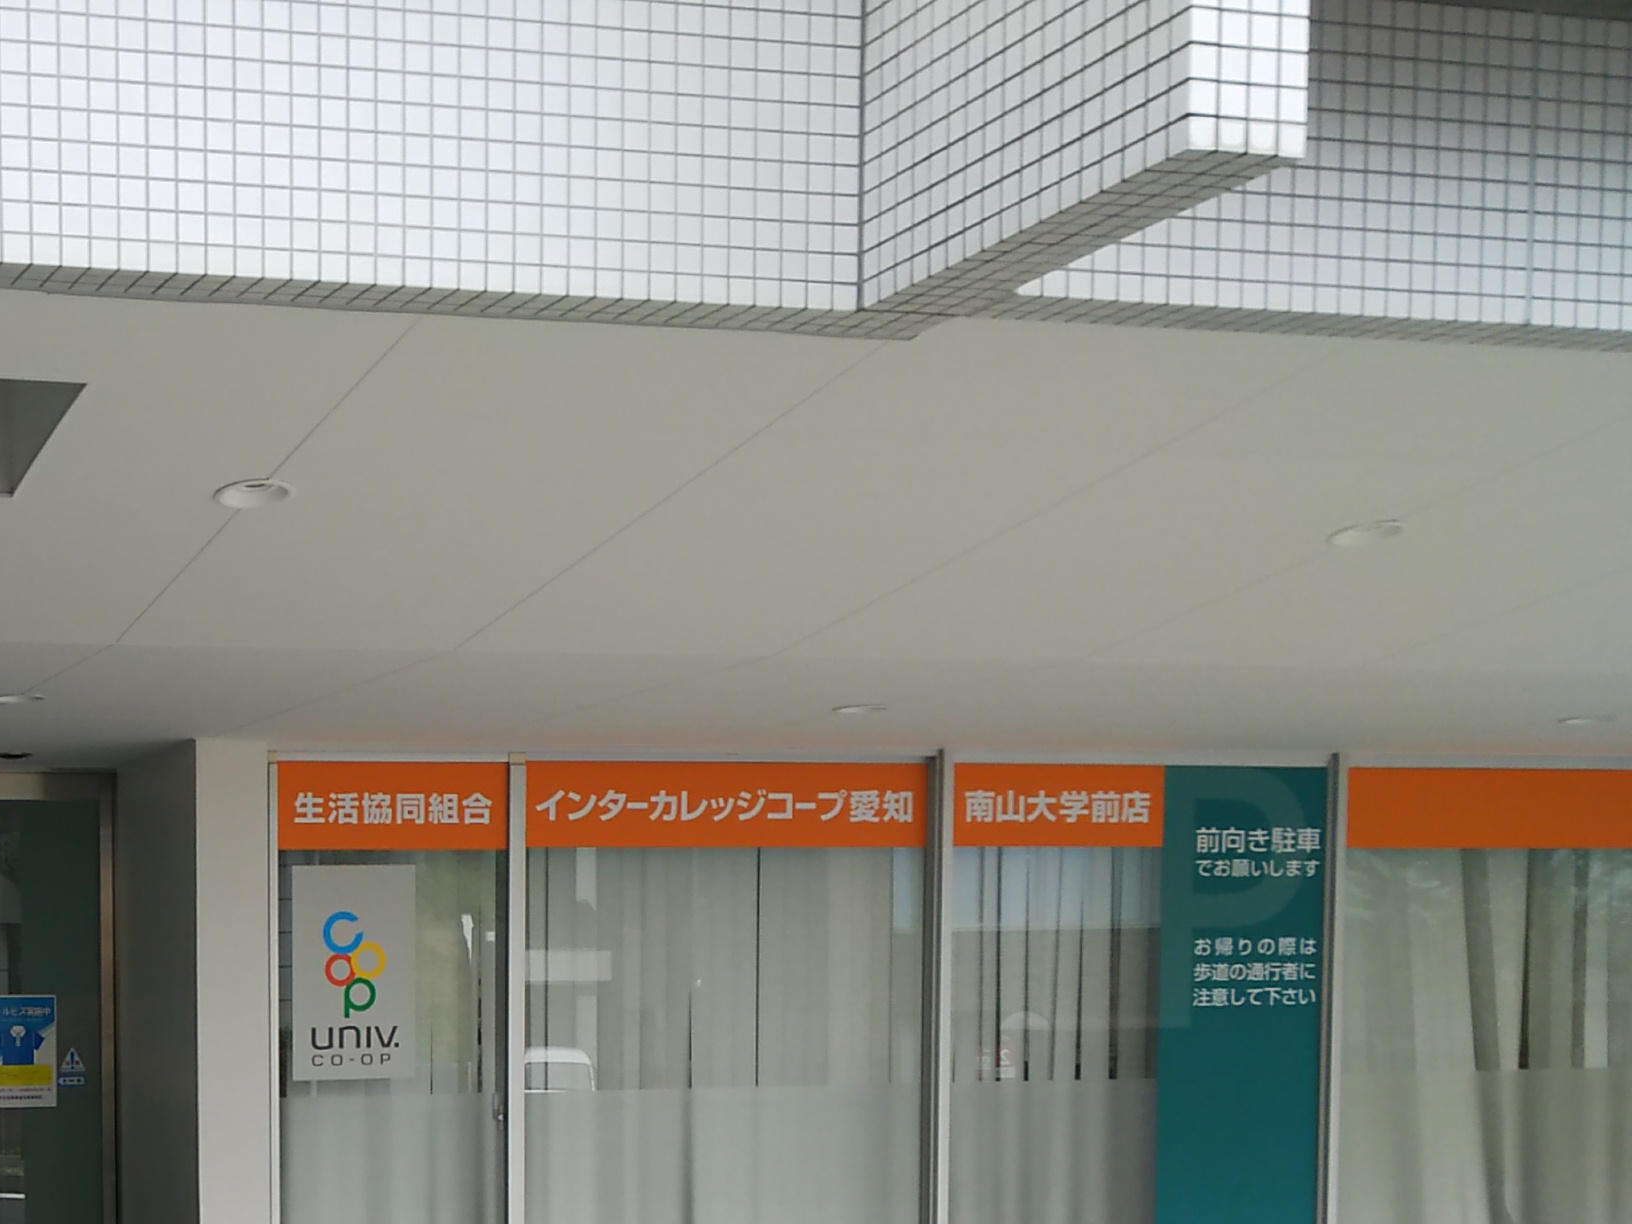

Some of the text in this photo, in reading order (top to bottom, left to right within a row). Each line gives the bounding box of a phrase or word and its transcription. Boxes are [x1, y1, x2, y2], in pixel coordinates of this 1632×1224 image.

[293, 791, 492, 825] 生活協同組合
[535, 788, 914, 824] インターカレッジコープ愛知
[965, 790, 1151, 824] 南山大学前店
[1195, 827, 1321, 853] 前向き駐車
[1195, 859, 1320, 877] でお願いします
[1193, 937, 1316, 956] お帰りの際は
[1193, 963, 1316, 981] 歩道の通行者に
[1192, 988, 1316, 1006] 注意して下さい
[310, 1025, 400, 1051] univ.
[311, 1053, 392, 1067] CO-OP
